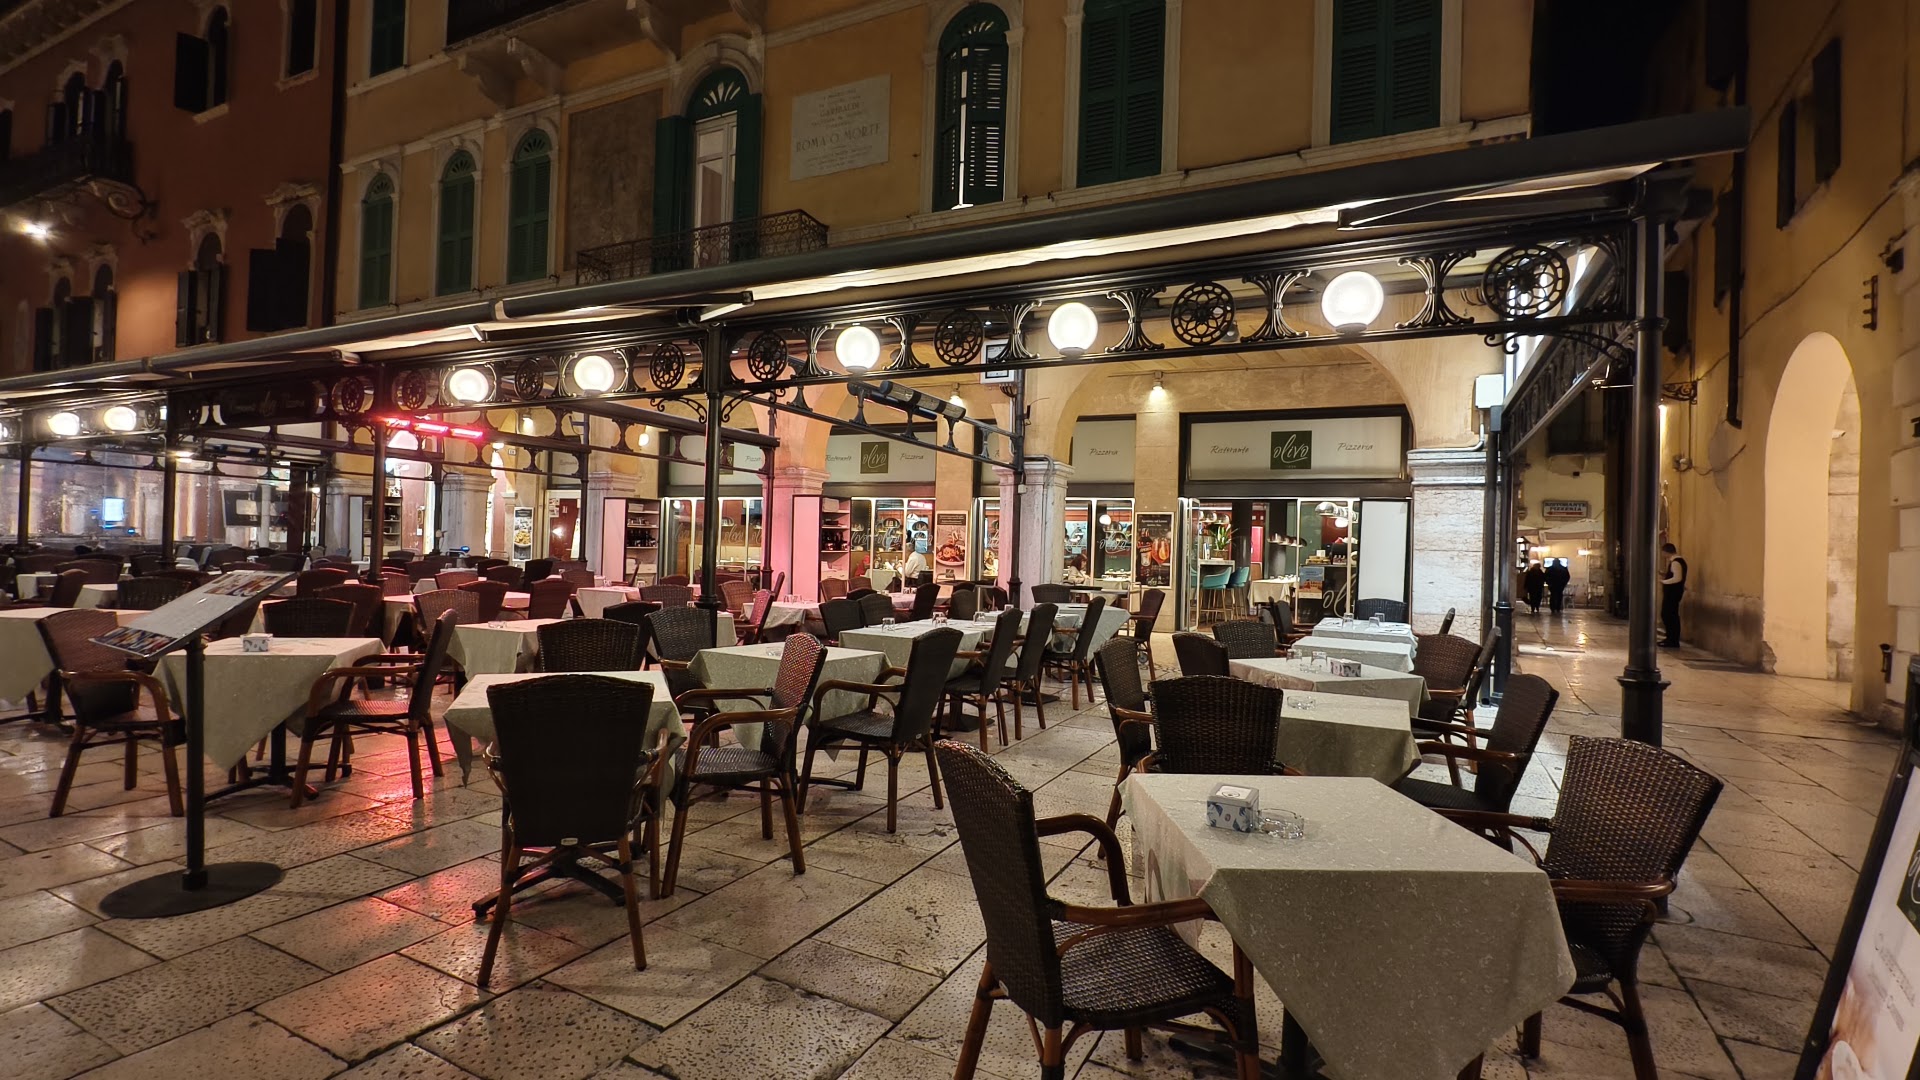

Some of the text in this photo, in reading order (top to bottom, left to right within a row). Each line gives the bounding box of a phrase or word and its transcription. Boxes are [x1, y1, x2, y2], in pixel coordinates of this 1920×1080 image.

[796, 137, 826, 153] ROMA
[830, 133, 840, 144] O
[861, 444, 887, 469] olivo
[1088, 448, 1119, 456] Pizzeria
[1210, 433, 1374, 464] Ristorante olivo Pizzeria
